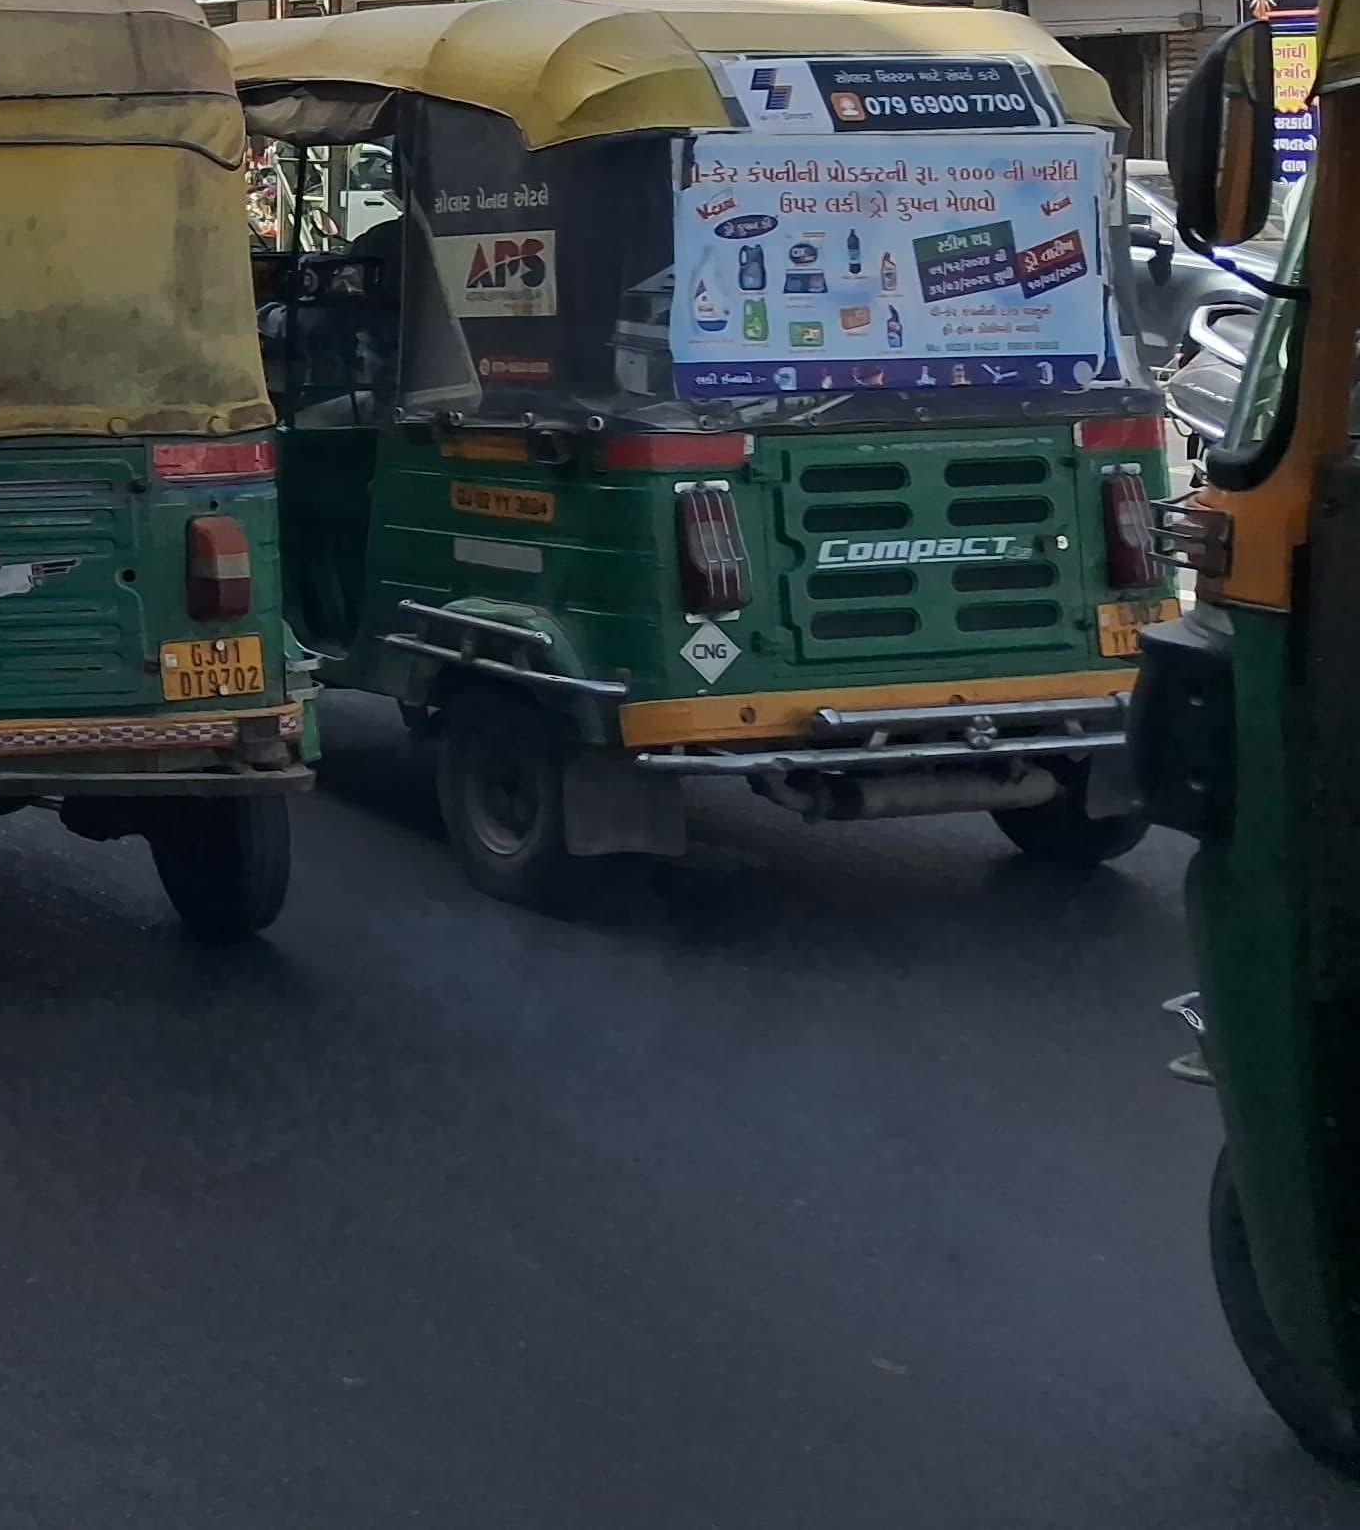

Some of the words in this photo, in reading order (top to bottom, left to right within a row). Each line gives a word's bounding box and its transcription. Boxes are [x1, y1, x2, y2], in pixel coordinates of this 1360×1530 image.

[865, 95, 907, 118] 079
[910, 93, 969, 116] 6900
[970, 92, 1027, 114] 7700
[746, 159, 820, 184] કંપનીની
[947, 166, 997, 183] ૧૦૦૦
[1002, 160, 1025, 182] ની
[1031, 158, 1079, 182] ખરીદી
[433, 189, 471, 215] સોલાર
[476, 186, 509, 211] પેનલ
[513, 181, 550, 208] એટલે
[779, 192, 819, 215] ઉપર
[824, 191, 862, 214] લકી
[895, 196, 938, 222] કુપન
[945, 189, 997, 214] મેળવો
[465, 238, 547, 289] APS
[815, 534, 1013, 568] Compact
[691, 642, 728, 661] CNG
[179, 665, 261, 697] DT9702
